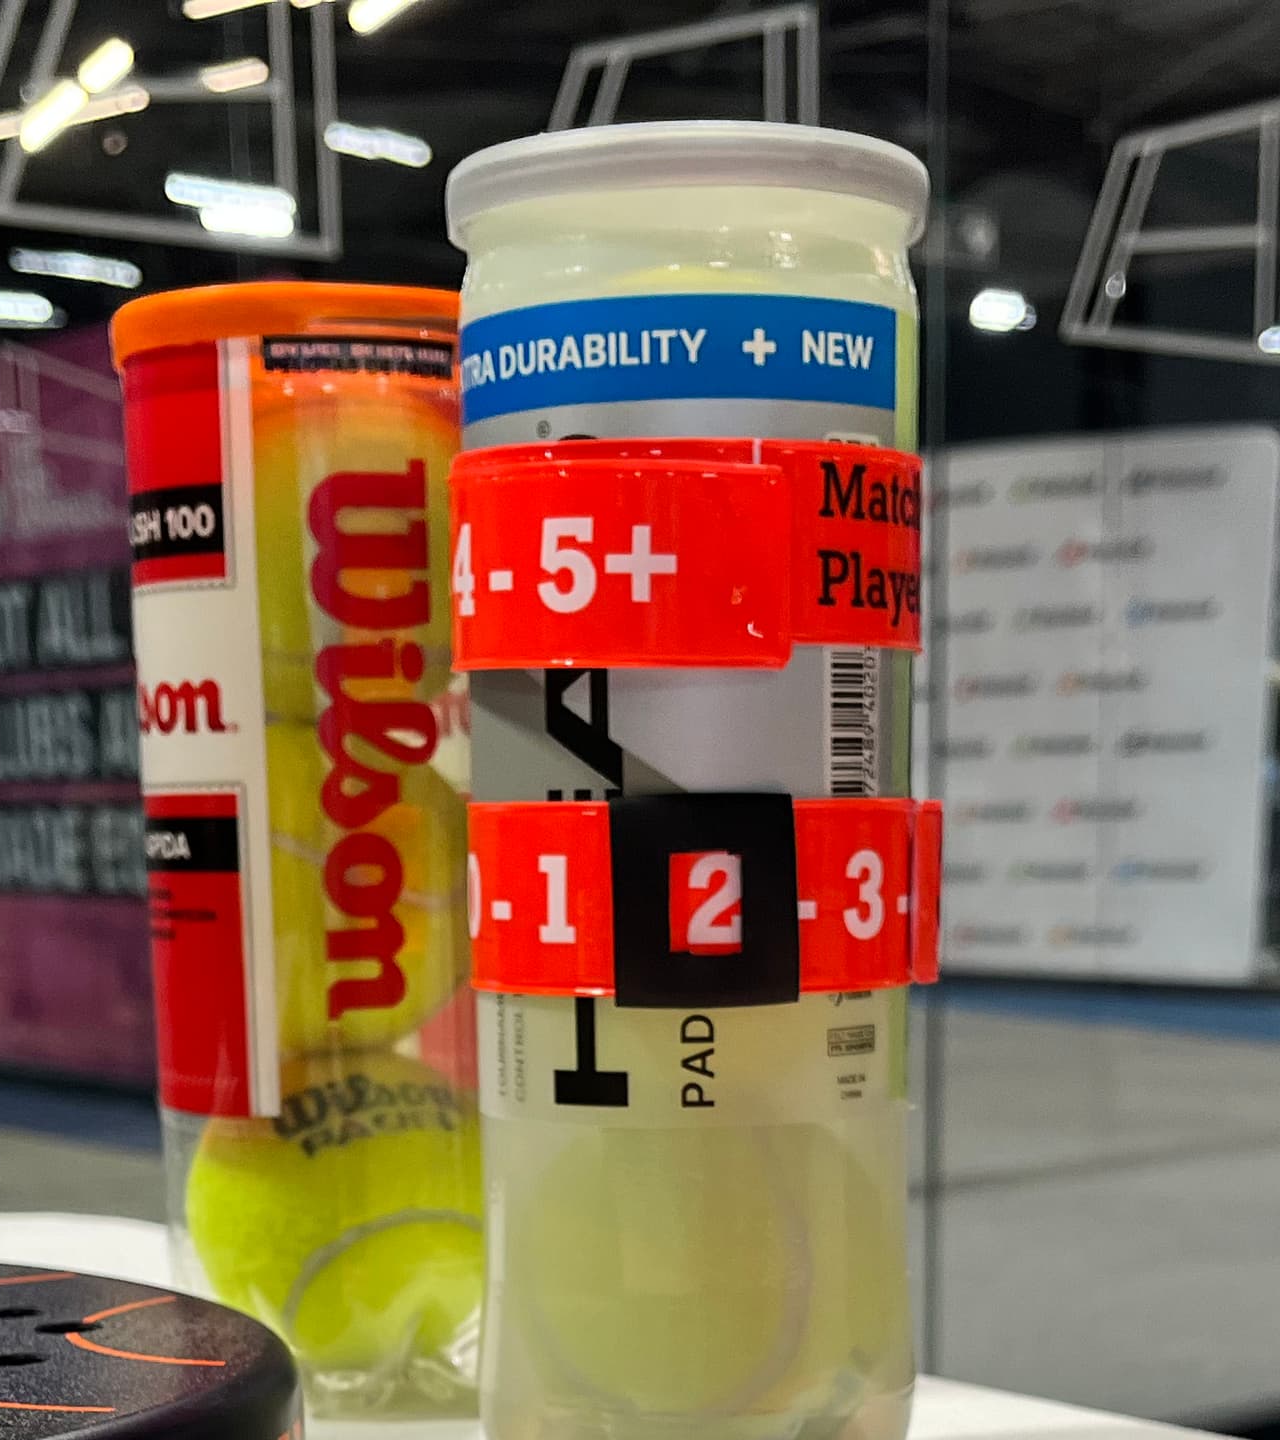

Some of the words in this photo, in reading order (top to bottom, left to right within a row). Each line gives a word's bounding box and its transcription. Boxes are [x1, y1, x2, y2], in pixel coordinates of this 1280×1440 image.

[499, 328, 707, 380] DURABILITY
[802, 330, 874, 370] NEW
[128, 509, 161, 544] SH
[164, 504, 215, 540] 100
[307, 458, 438, 1022] Wilson
[687, 852, 743, 944] 2
